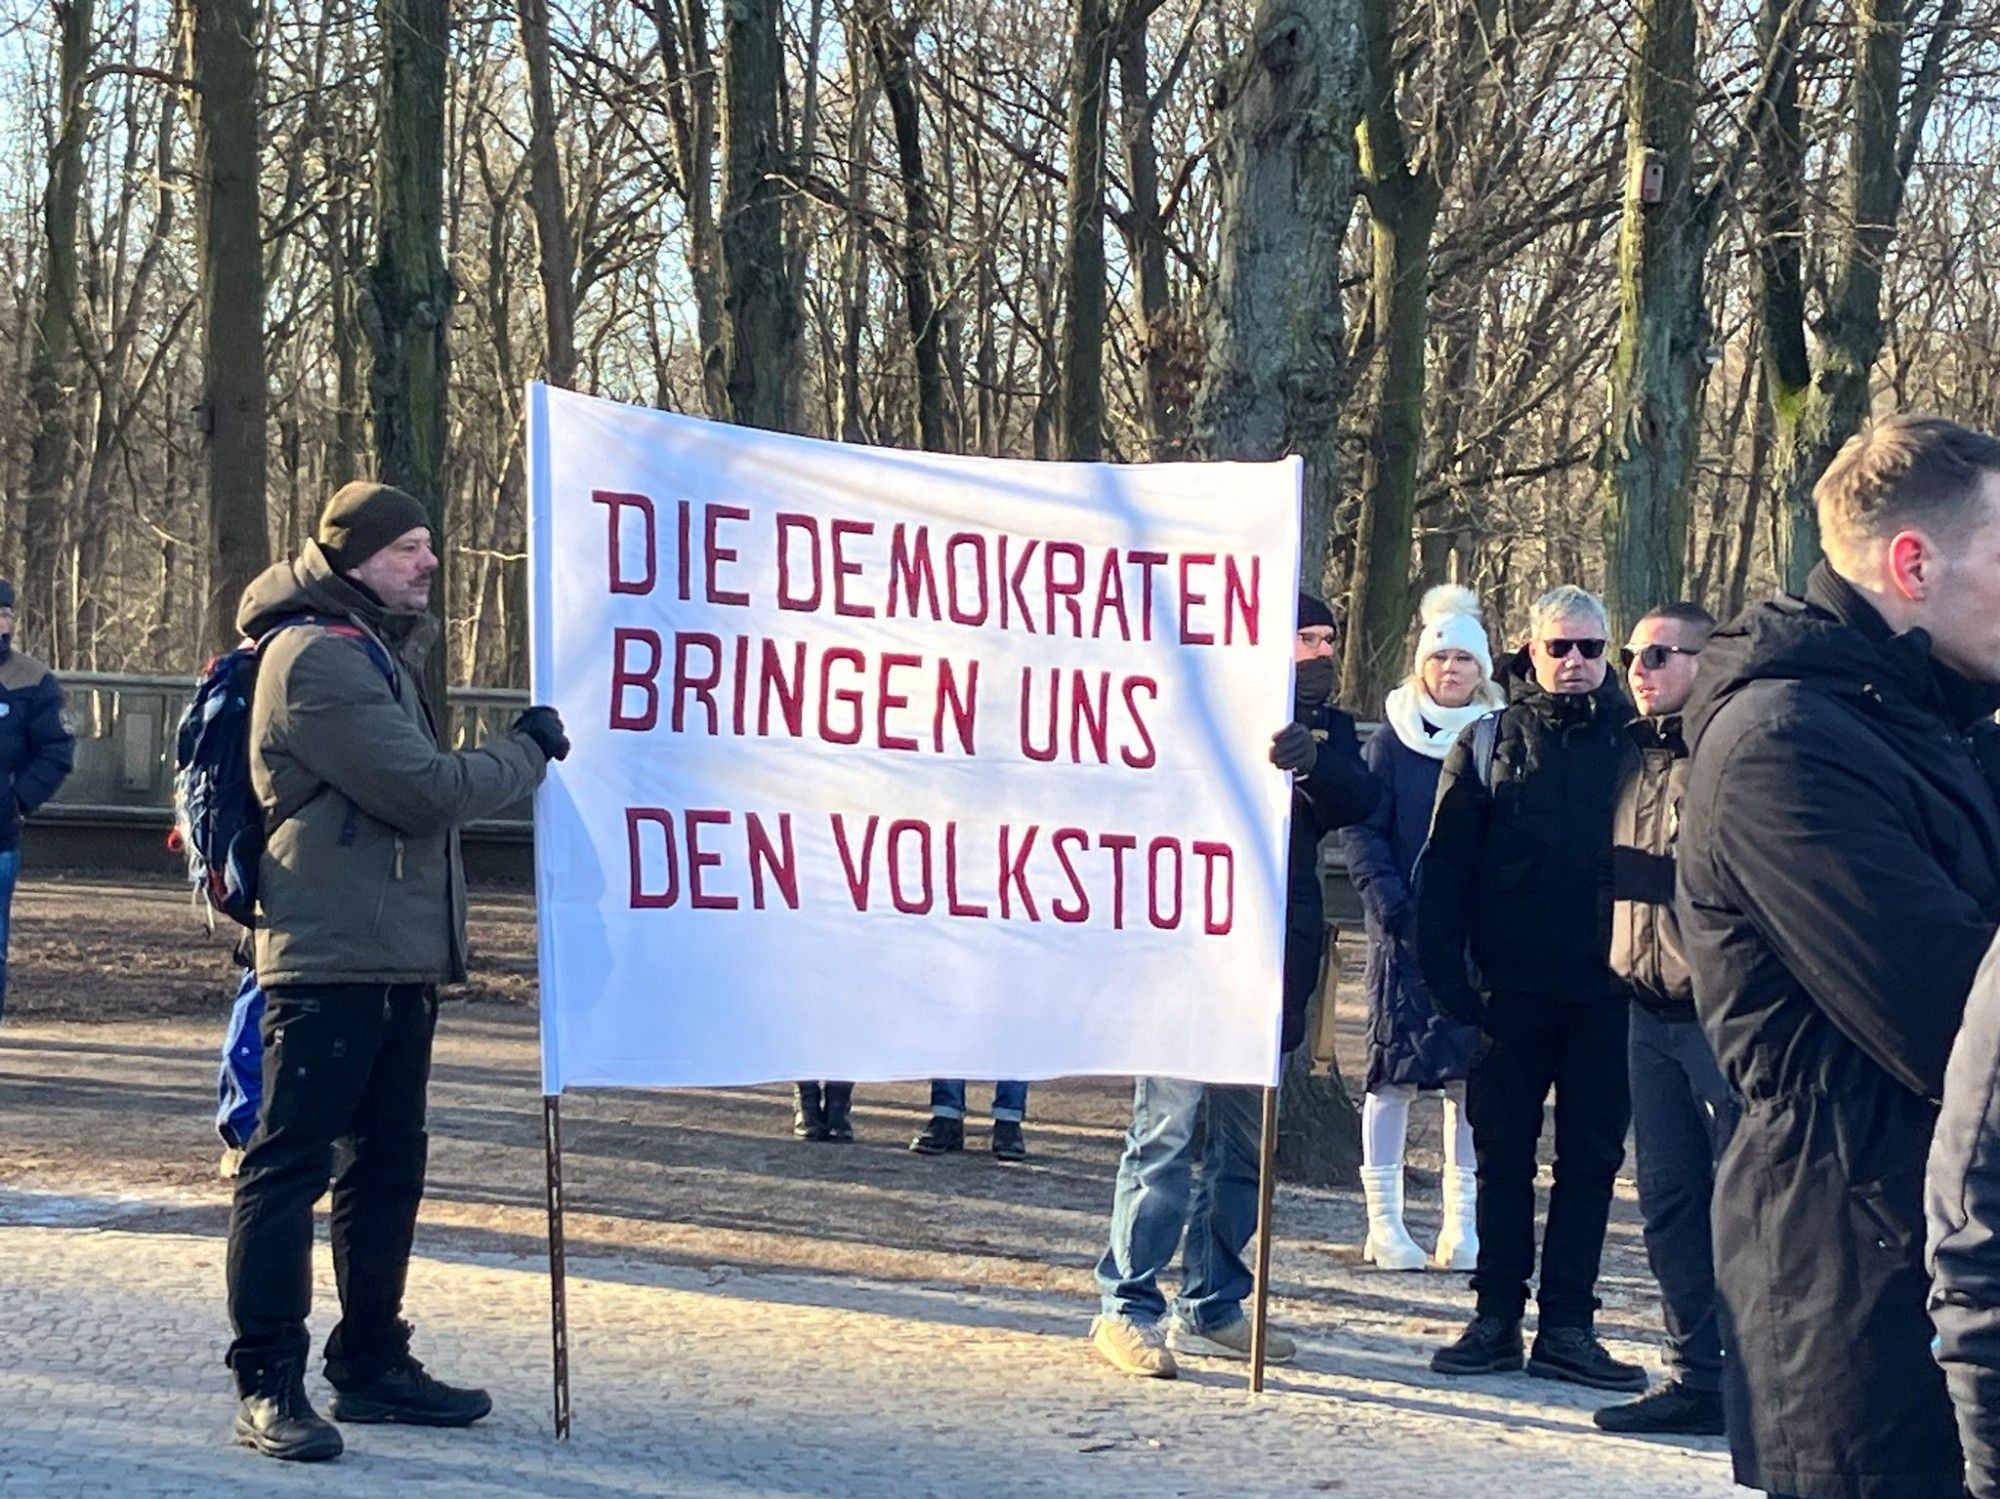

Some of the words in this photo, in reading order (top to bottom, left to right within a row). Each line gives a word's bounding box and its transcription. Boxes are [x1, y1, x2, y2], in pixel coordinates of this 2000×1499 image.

[592, 490, 750, 607] DIE
[776, 512, 1261, 646] DEMOKRATEN
[608, 627, 979, 756] BRINGEN
[1019, 666, 1159, 769] UNS
[625, 807, 799, 910] DEN
[830, 812, 1235, 936] VOLKSTOD
